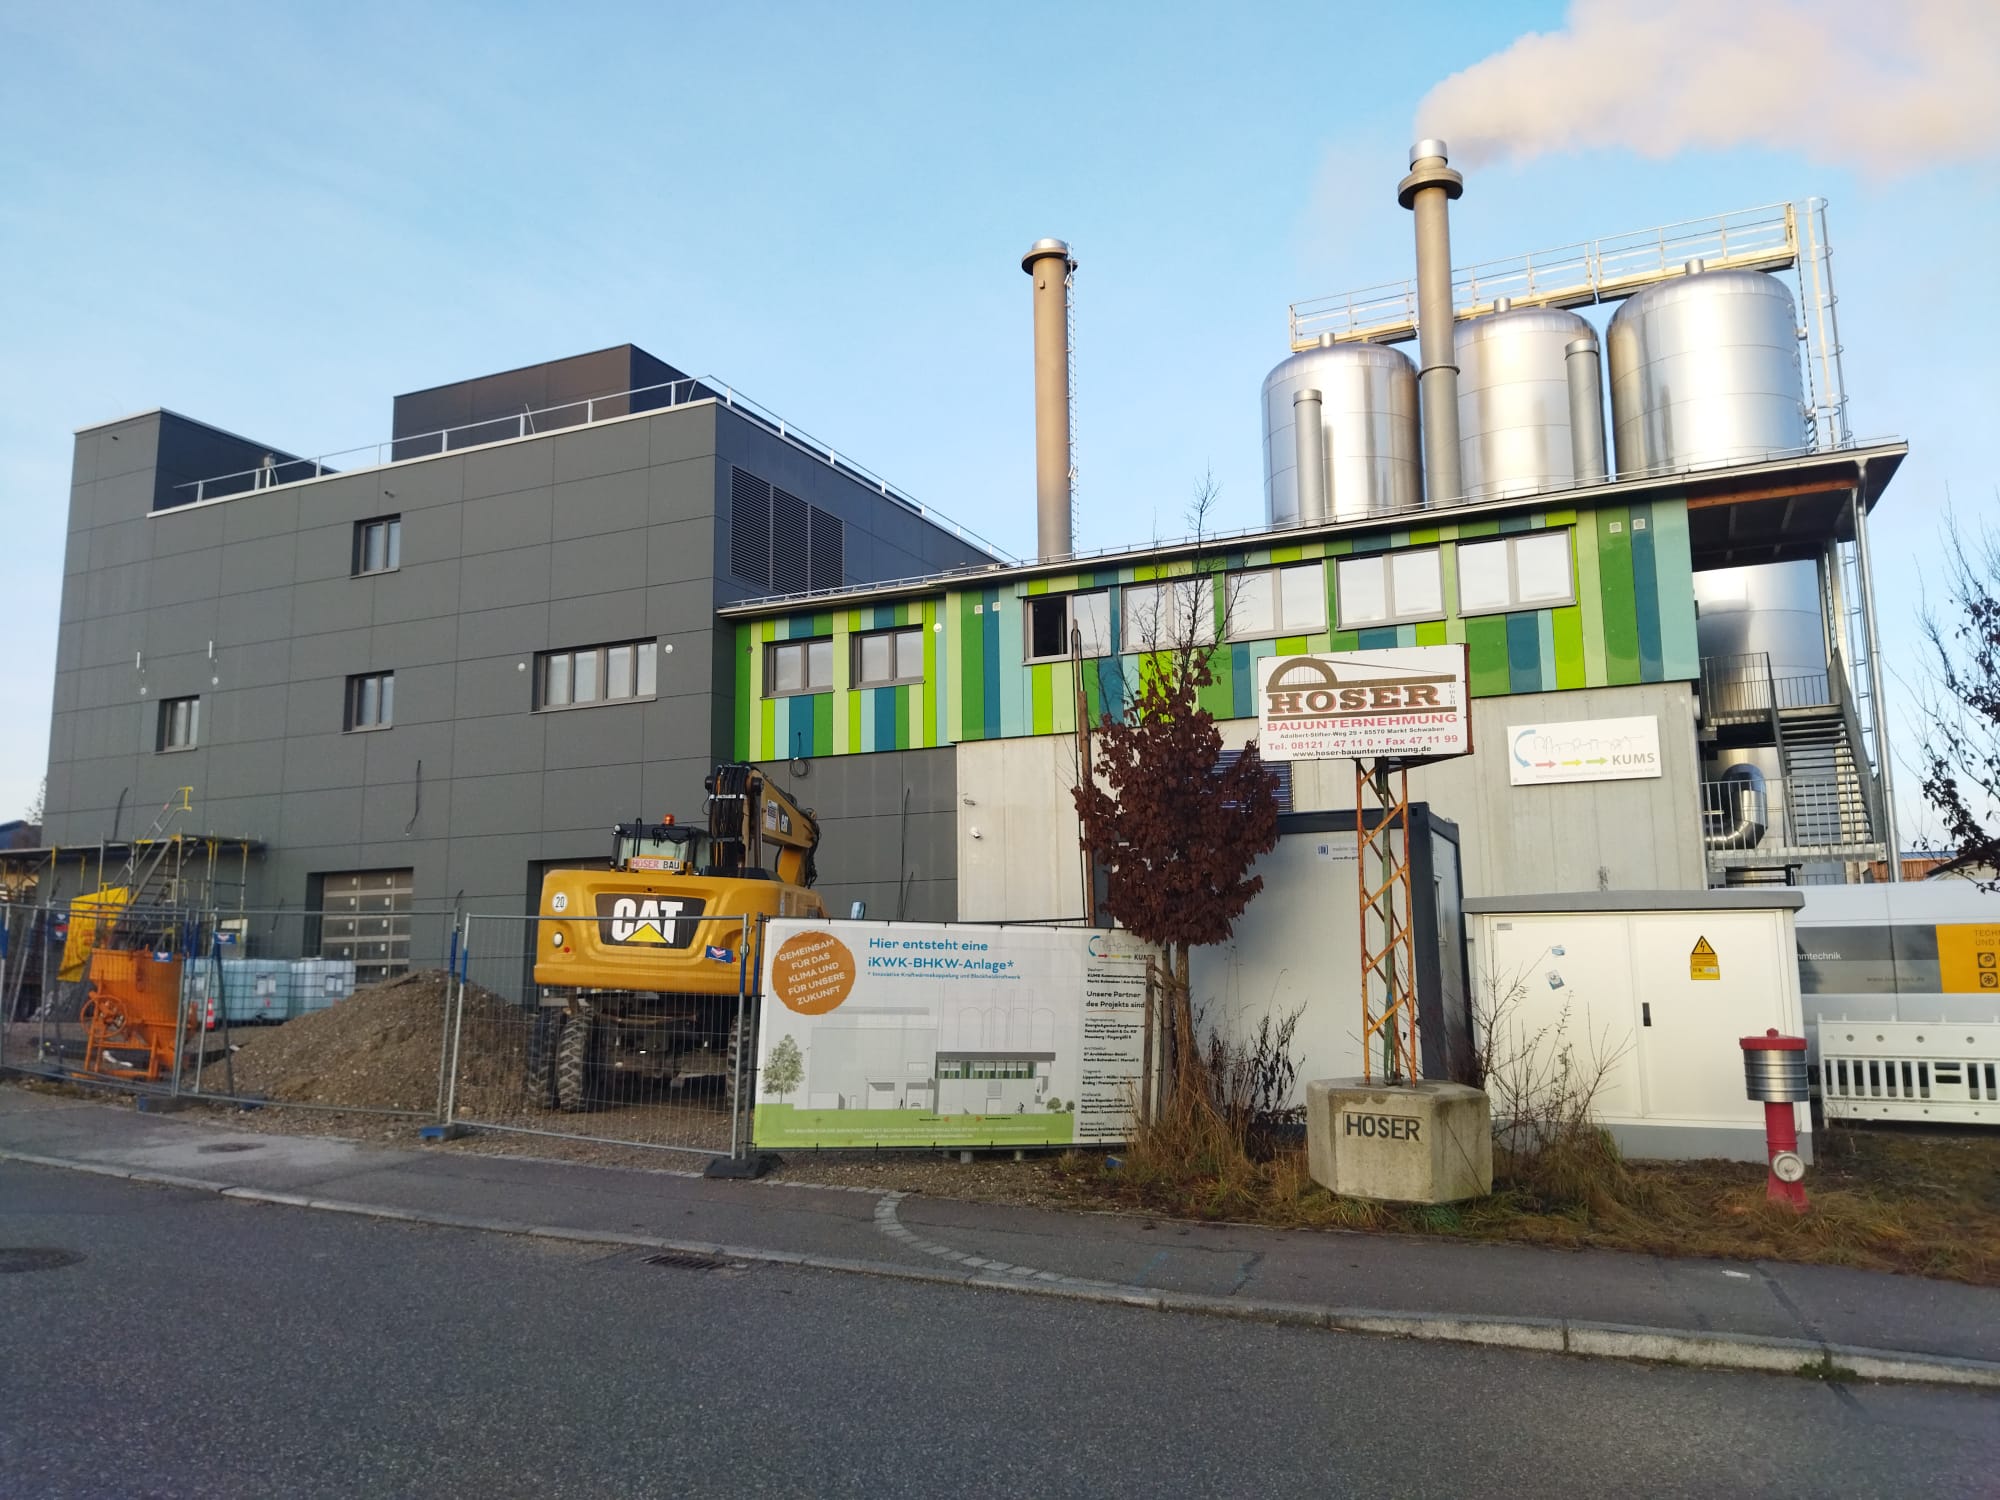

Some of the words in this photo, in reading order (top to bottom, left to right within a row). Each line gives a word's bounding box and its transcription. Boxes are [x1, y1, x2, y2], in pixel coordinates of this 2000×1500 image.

[1267, 685, 1441, 714] HOSER
[1267, 714, 1457, 731] BAUUNTERNEHMUNG
[1268, 743, 1287, 751] Tel.
[1291, 741, 1323, 750] 08121
[1333, 740, 1346, 748] 47
[1351, 739, 1363, 747] 11
[1367, 738, 1373, 746] 0
[1385, 737, 1405, 746] Fax
[1409, 736, 1422, 744] 47
[1428, 735, 1439, 743] 11
[1444, 734, 1458, 743] 99
[1292, 746, 1432, 757] www.hoser-bauunternehmung.de
[1612, 752, 1655, 766] KUMS
[663, 860, 679, 870] BAU
[555, 896, 565, 908] 20
[612, 898, 683, 944] CAT
[779, 938, 835, 961] GEMEINSAM
[869, 937, 899, 949] Hier
[902, 938, 958, 950] entsteht
[961, 940, 988, 951] eine
[811, 952, 831, 964] DAS
[788, 968, 818, 983] KLIMA
[818, 962, 839, 974] UND
[808, 971, 846, 989] UNSERE
[796, 985, 841, 1005] ZUKUNFT
[1086, 990, 1112, 998] Unsere
[1100, 1000, 1129, 1009] Projekts
[1346, 1114, 1421, 1142] HOSER
